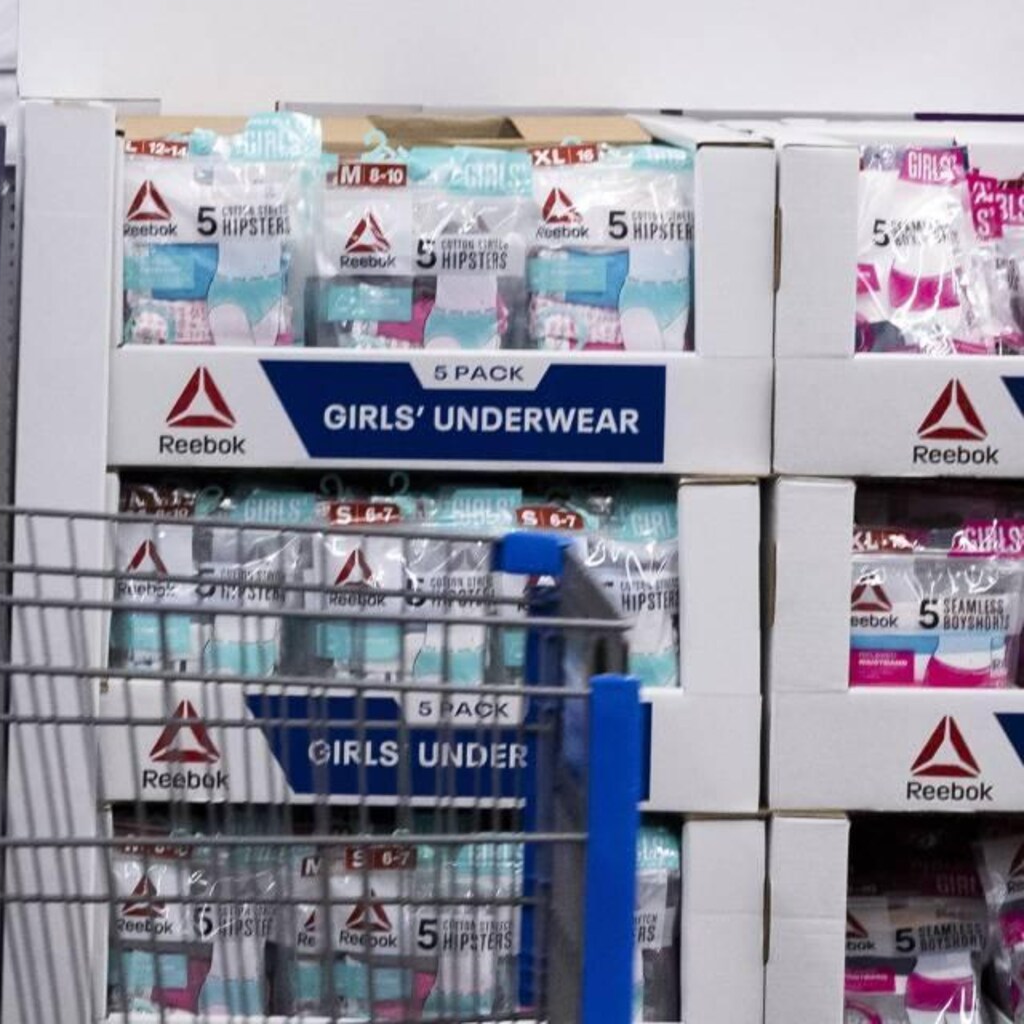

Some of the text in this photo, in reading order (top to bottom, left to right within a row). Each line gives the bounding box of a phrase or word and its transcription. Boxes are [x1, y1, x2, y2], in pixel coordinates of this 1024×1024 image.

[148, 141, 188, 157] 12-14
[533, 149, 594, 166] XL 16
[340, 165, 404, 184] M 8-10
[196, 206, 218, 237] 5
[608, 210, 629, 240] 5
[535, 225, 590, 239] Reebok
[872, 219, 890, 247] 5
[339, 255, 396, 269] Reebok
[416, 238, 437, 269] 5
[441, 250, 508, 270] HIPSTERS
[433, 365, 524, 383] 5 PACK
[323, 403, 640, 435] GIRLS' UNDERWEAR
[158, 435, 246, 456] Reebok
[912, 445, 999, 465] Reebok
[336, 505, 393, 524] S 6-7
[521, 509, 576, 528] S 6-7
[621, 591, 679, 612] HIPSTER
[943, 599, 1005, 615] SEAMLESS
[918, 599, 940, 629] 5
[418, 701, 509, 718] 5 PACK
[142, 769, 228, 790] Reebok
[905, 782, 993, 802] Reebok
[382, 850, 410, 865] 6-7
[417, 918, 439, 950] 5
[442, 930, 513, 952] HIPSTERS
[895, 928, 916, 953] 5
